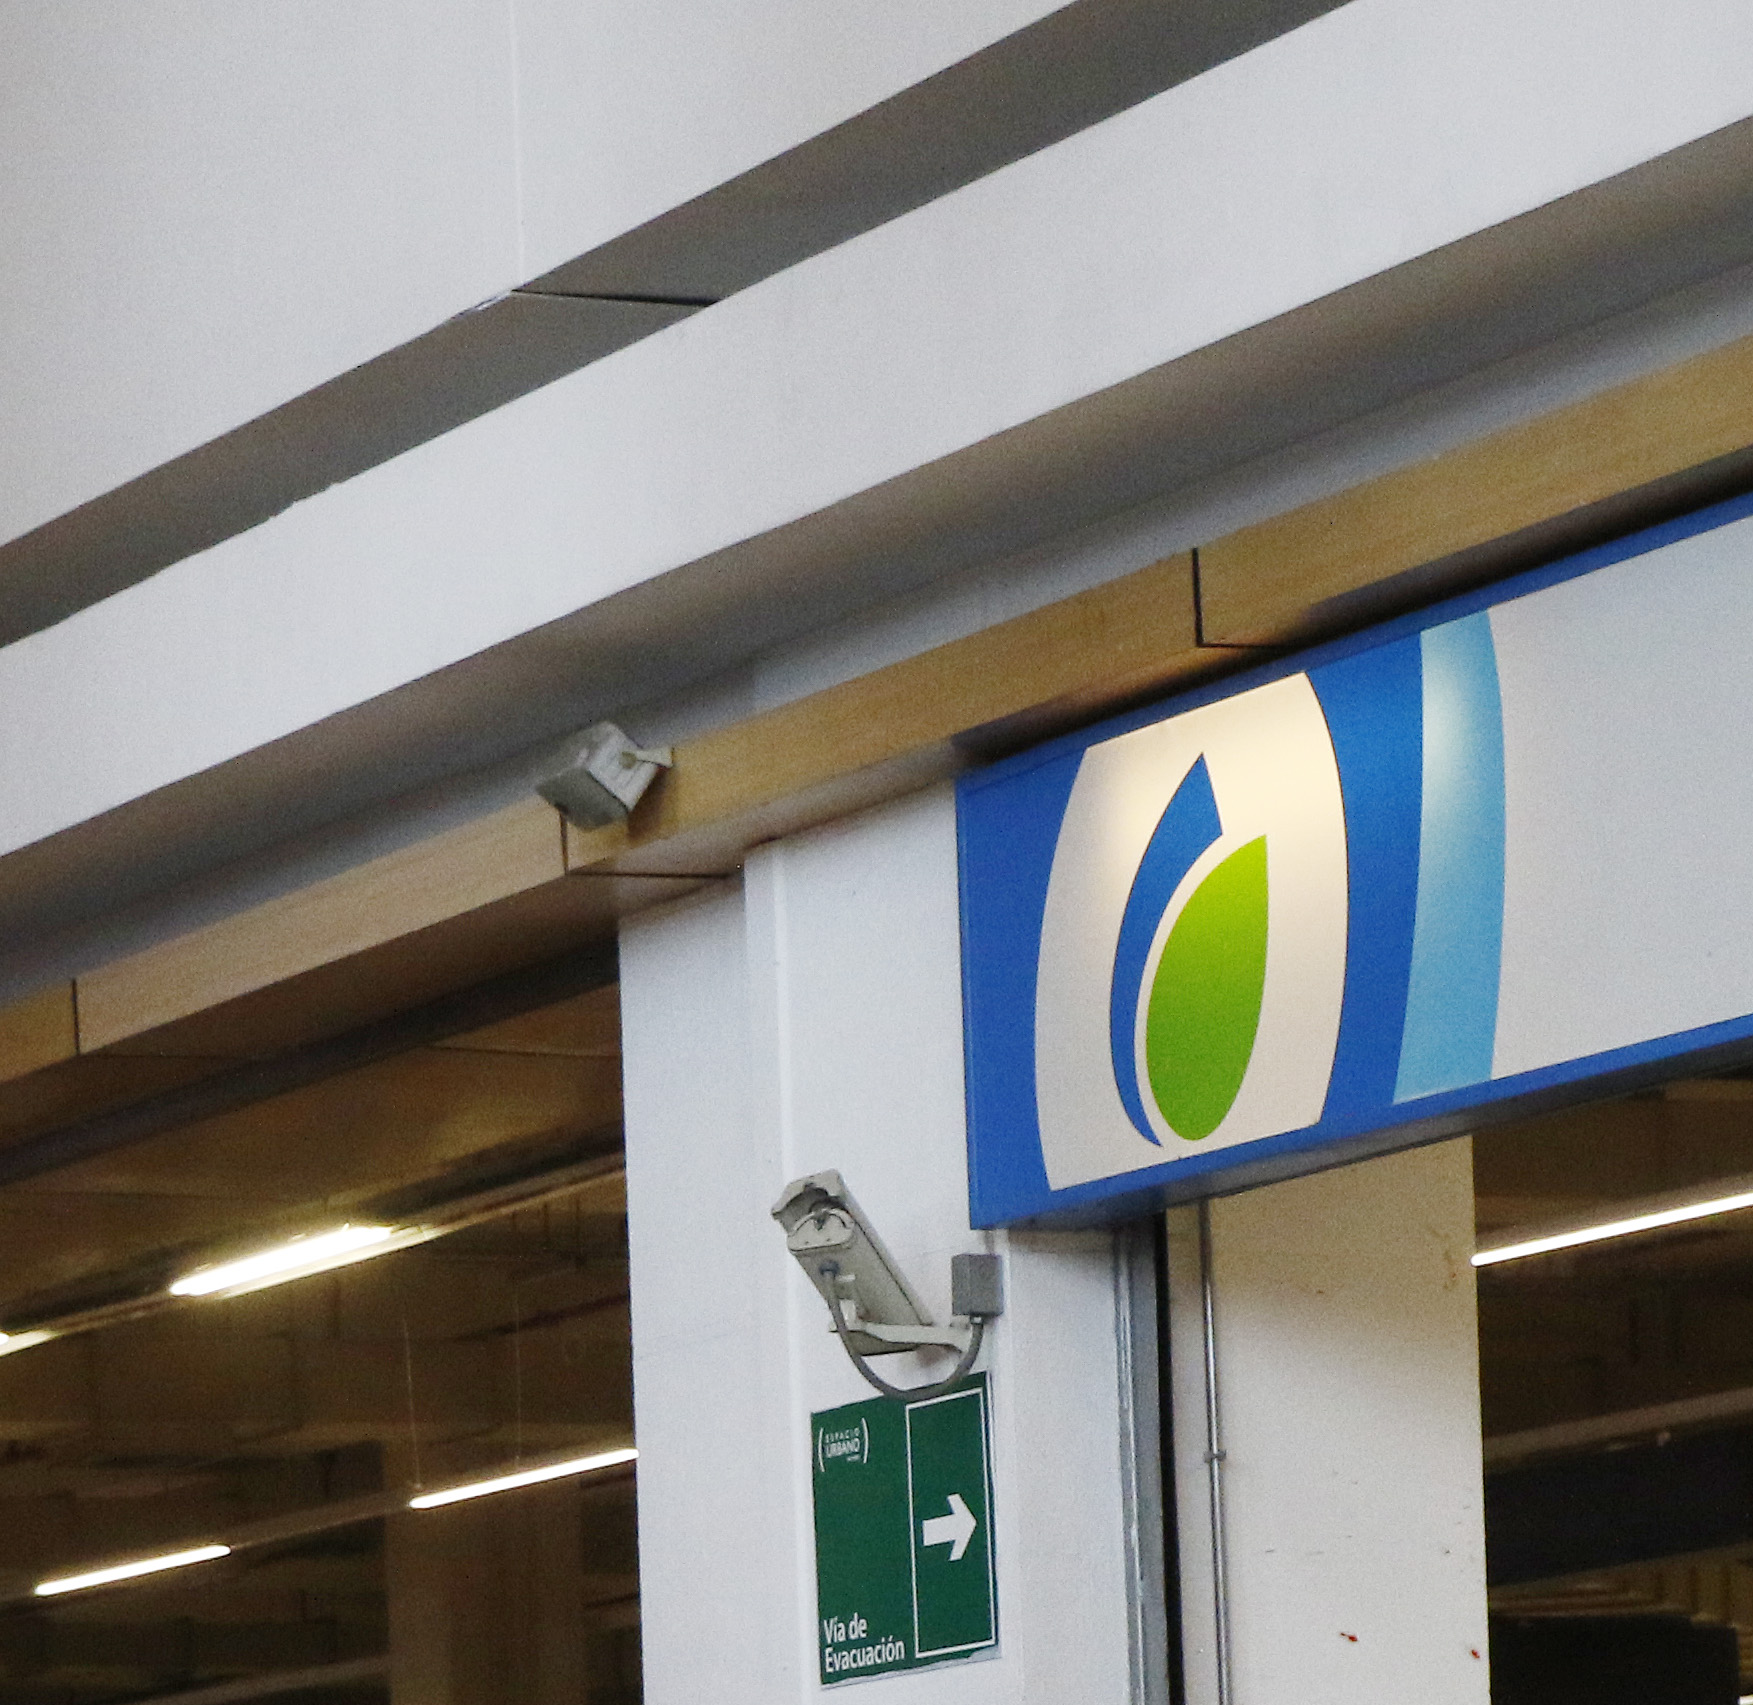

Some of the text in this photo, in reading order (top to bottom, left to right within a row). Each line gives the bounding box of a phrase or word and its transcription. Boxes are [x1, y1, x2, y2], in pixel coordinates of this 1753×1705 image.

[824, 1612, 868, 1645] Vía de
[825, 1635, 905, 1673] Evacuación
